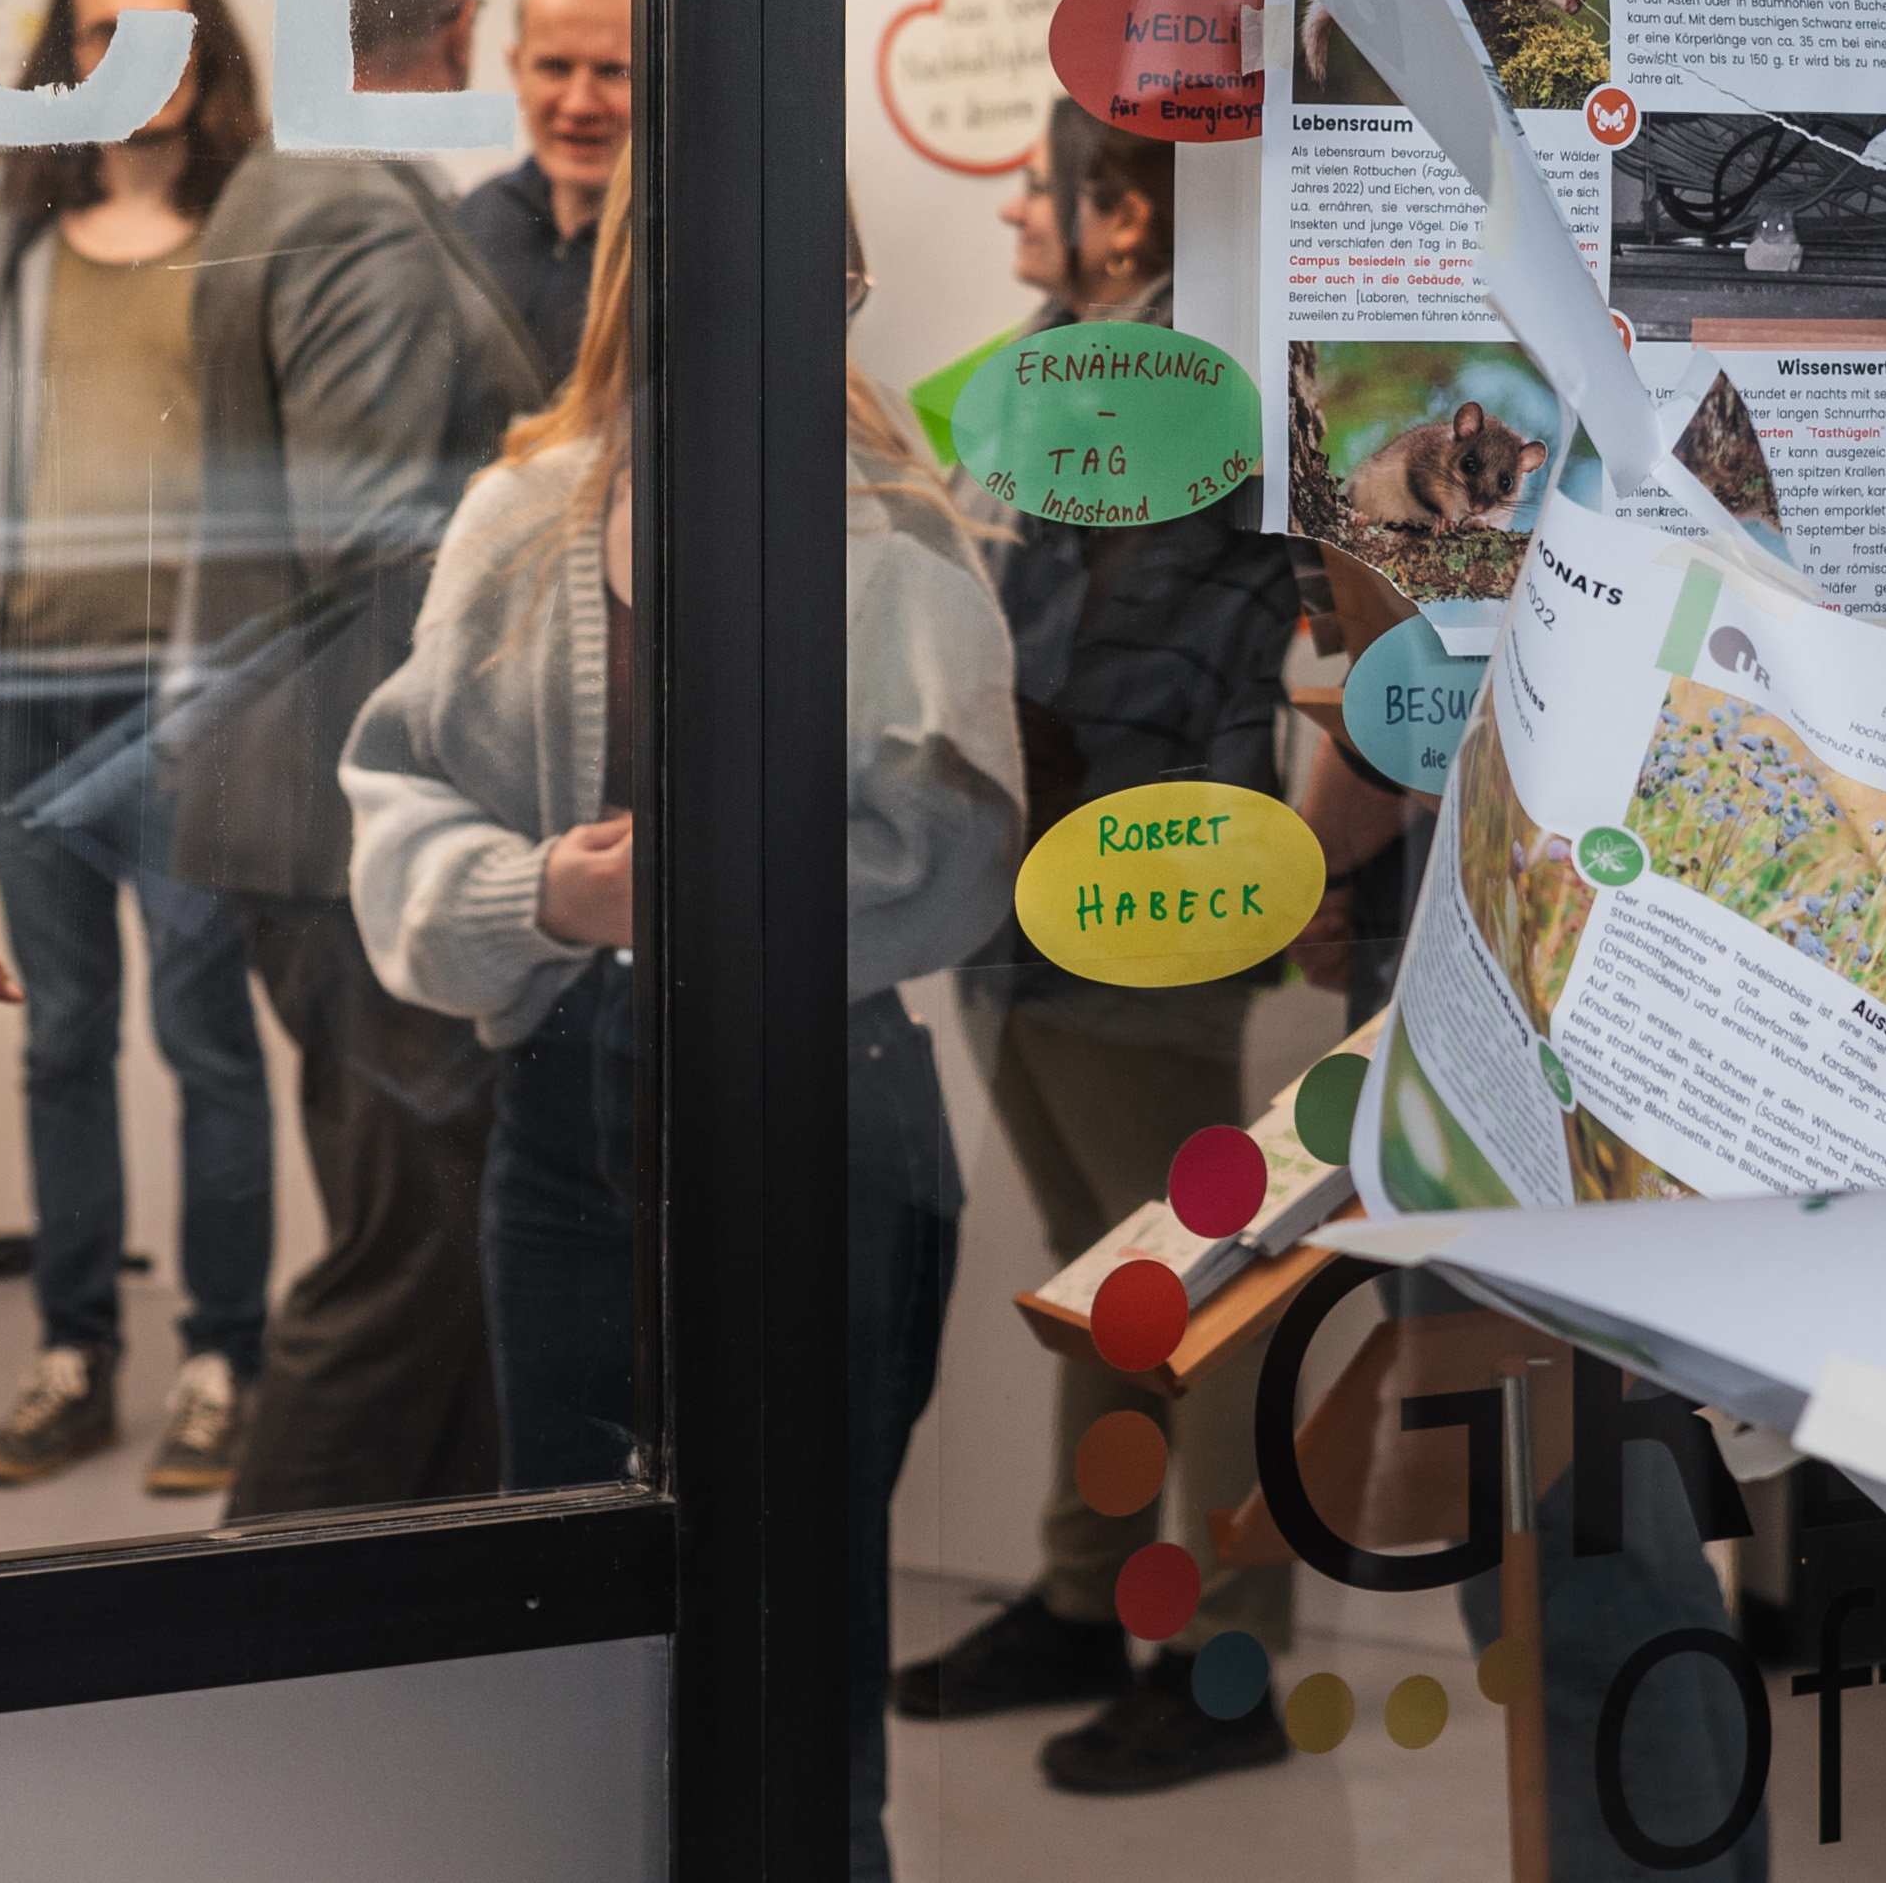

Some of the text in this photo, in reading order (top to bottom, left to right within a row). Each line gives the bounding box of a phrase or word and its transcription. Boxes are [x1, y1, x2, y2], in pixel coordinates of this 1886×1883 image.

[1138, 70, 1256, 96] professorin
[1110, 95, 1141, 120] für
[1293, 114, 1413, 134] Lebensraum
[1291, 145, 1309, 157] Als
[1314, 146, 1385, 158] Lebensraum
[1289, 273, 1465, 287] aber auch in die Gebäude,
[1016, 343, 1225, 386] ERNÄHRUNGS
[1048, 445, 1126, 476] TAG
[986, 471, 1017, 501] als
[1041, 488, 1150, 524] Infostand
[1421, 747, 1447, 770] die
[1853, 749, 1866, 761] &
[1099, 815, 1230, 856] ROBERT
[1076, 883, 1263, 931] HABECK
